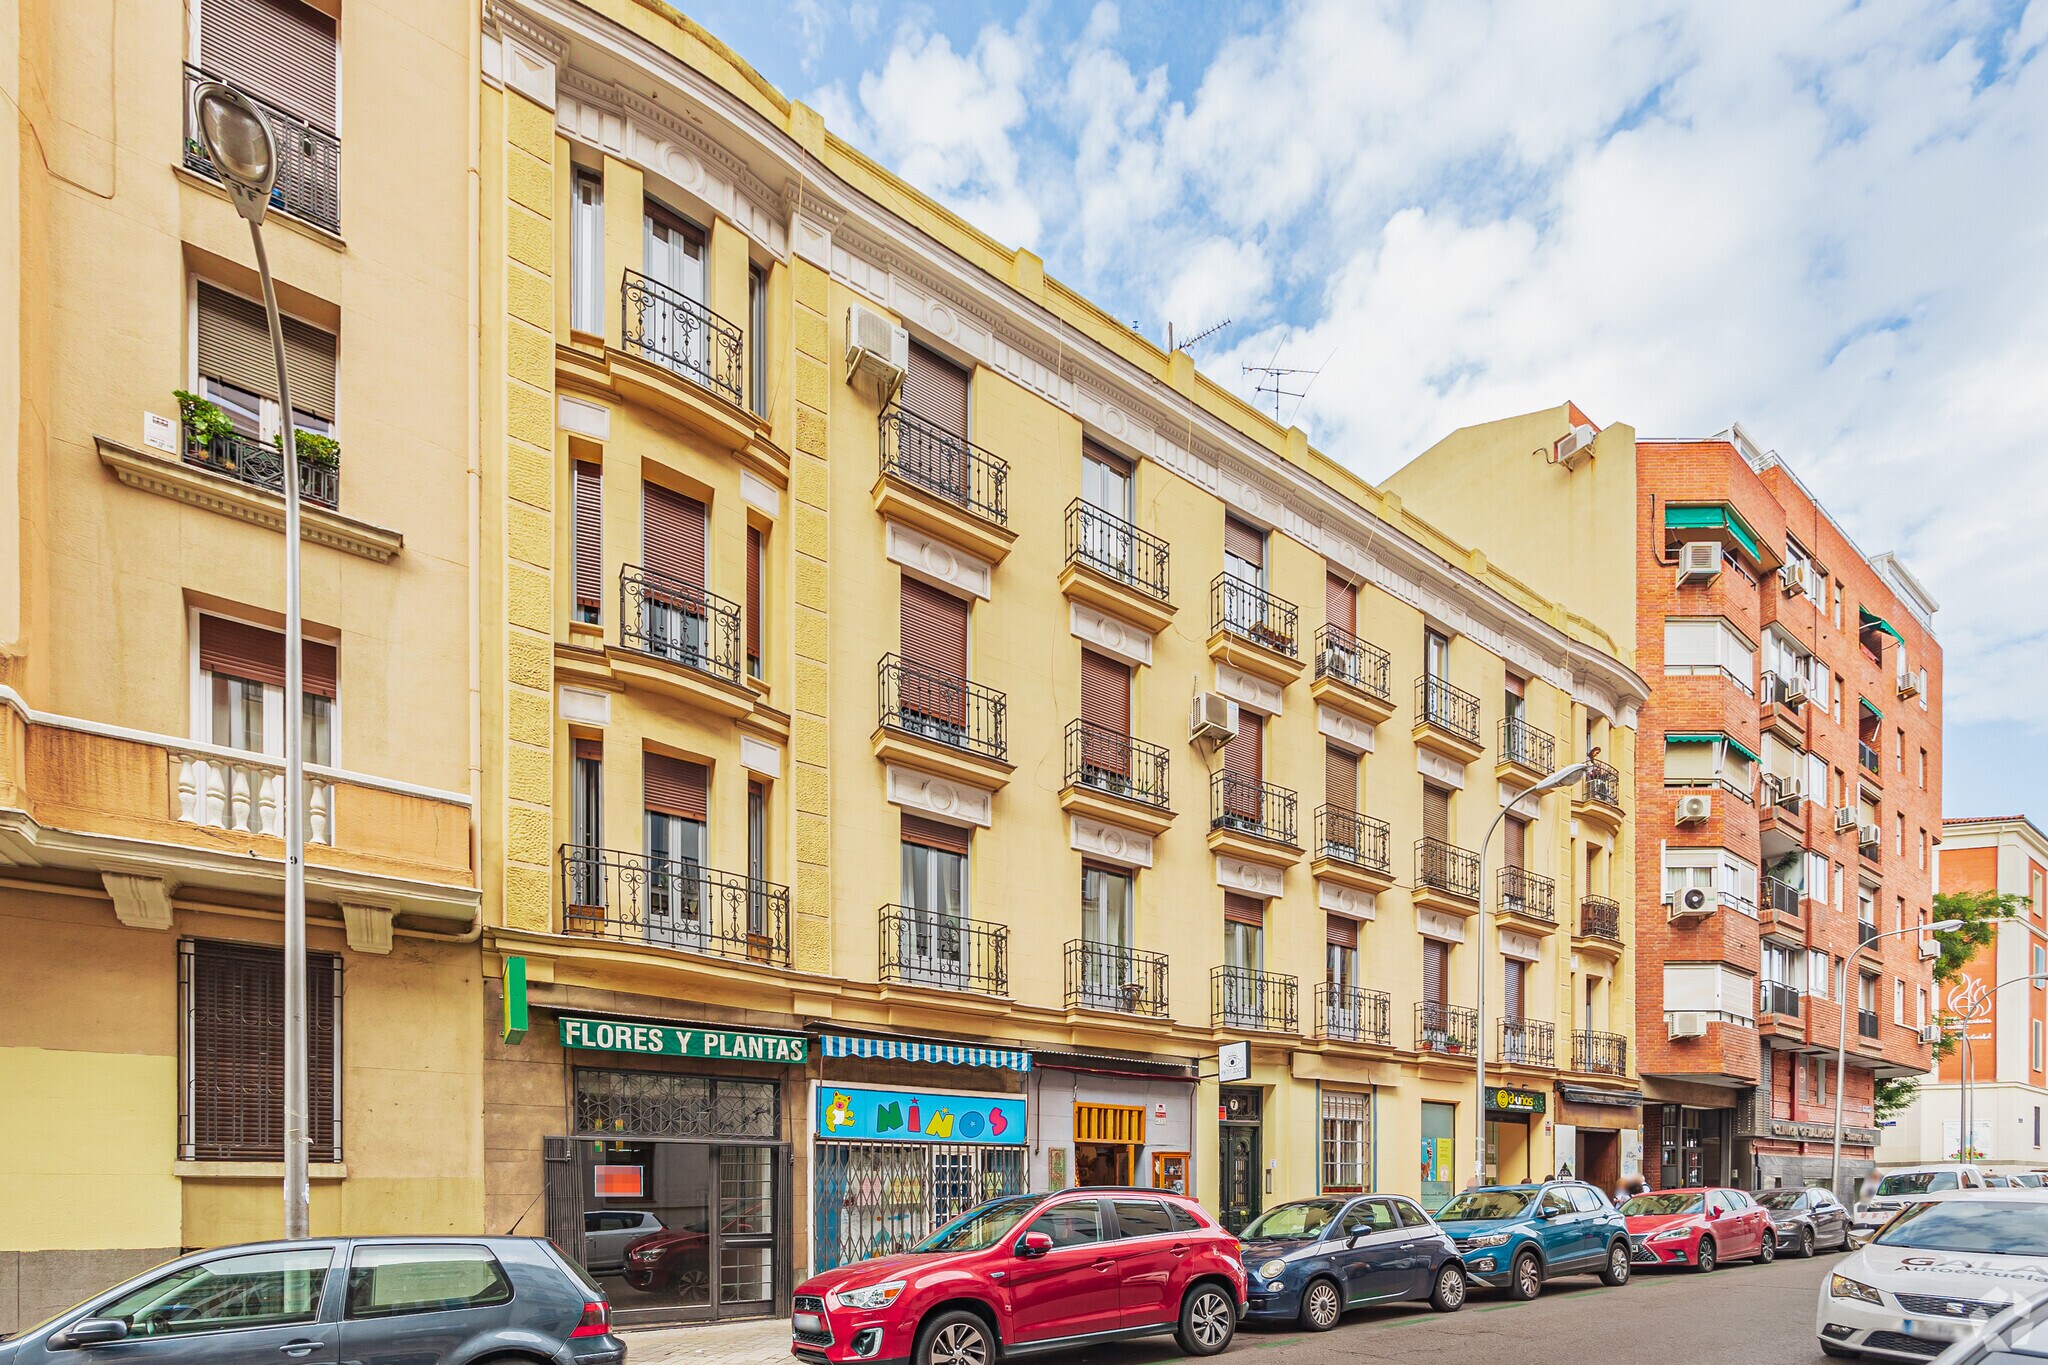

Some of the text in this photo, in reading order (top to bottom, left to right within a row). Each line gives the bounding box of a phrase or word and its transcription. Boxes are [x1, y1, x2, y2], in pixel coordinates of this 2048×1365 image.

[565, 1021, 803, 1061] FLORES Y PLANTAS
[1232, 1101, 1236, 1109] 7
[1894, 1265, 2048, 1283] Autoescuela
[1901, 1257, 2048, 1276] GALA
